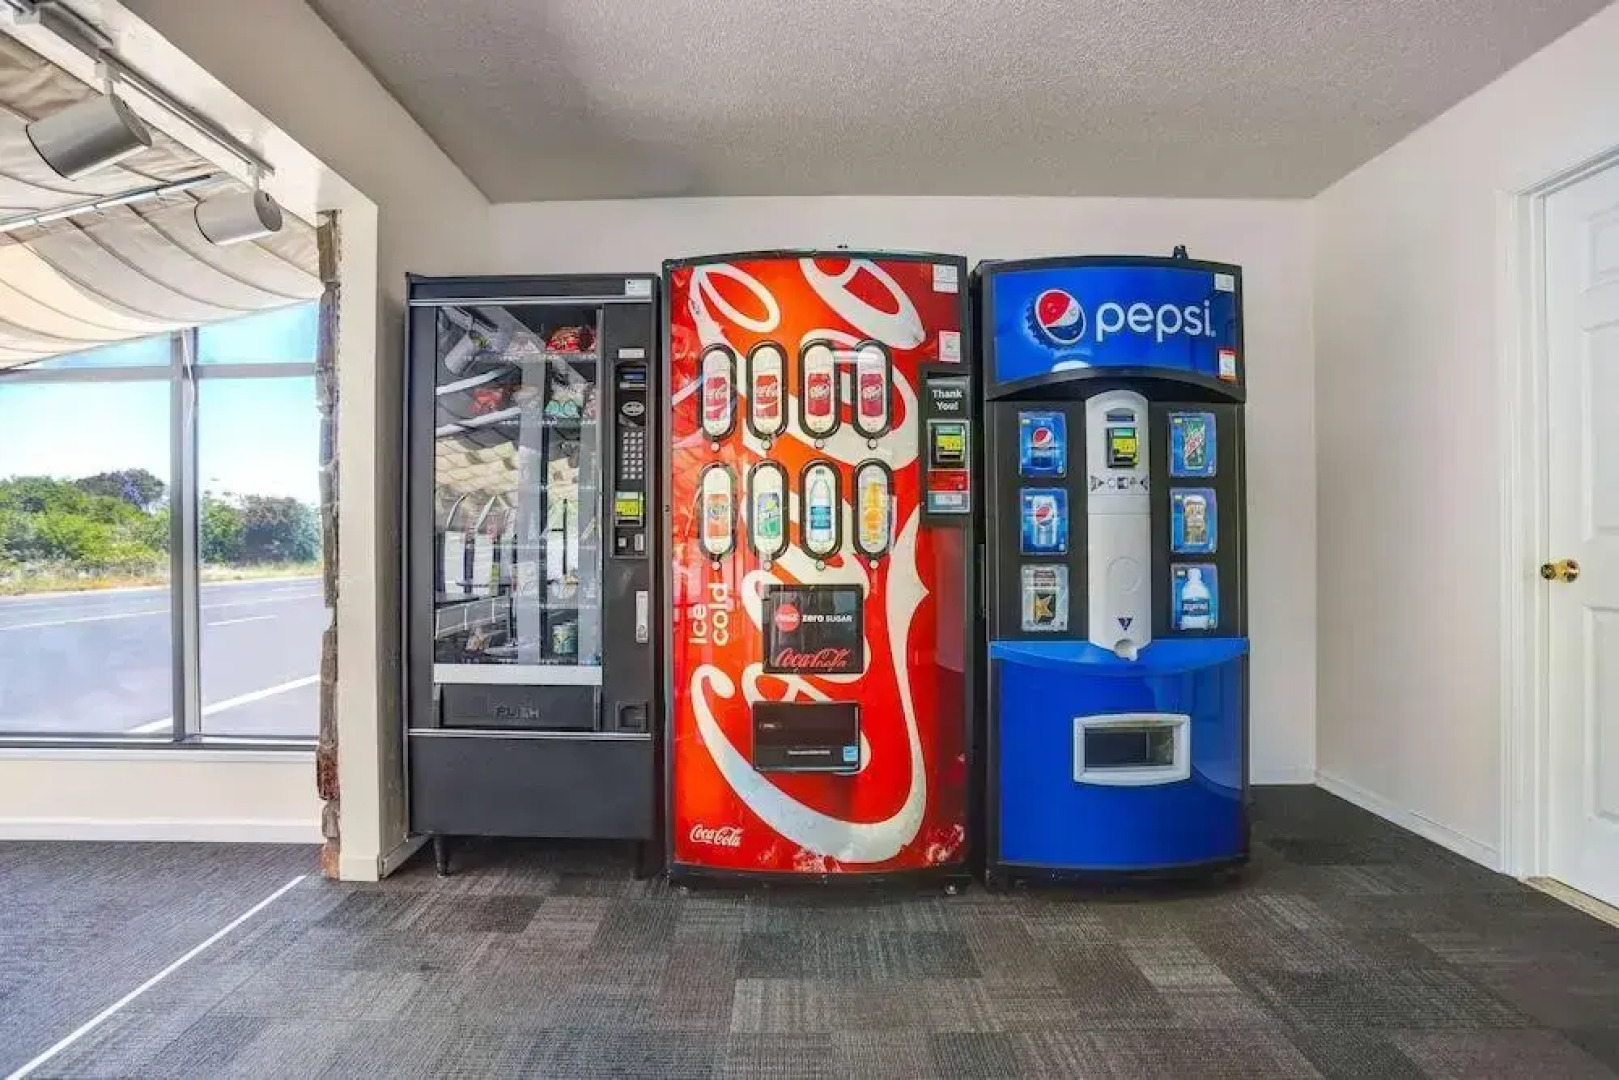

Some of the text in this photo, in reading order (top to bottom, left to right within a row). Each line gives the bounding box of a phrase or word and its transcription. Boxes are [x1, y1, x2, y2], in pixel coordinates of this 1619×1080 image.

[1096, 300, 1211, 342] pepsi
[932, 389, 962, 398] Thank
[707, 583, 729, 646] cold
[825, 614, 853, 623] SUGAR
